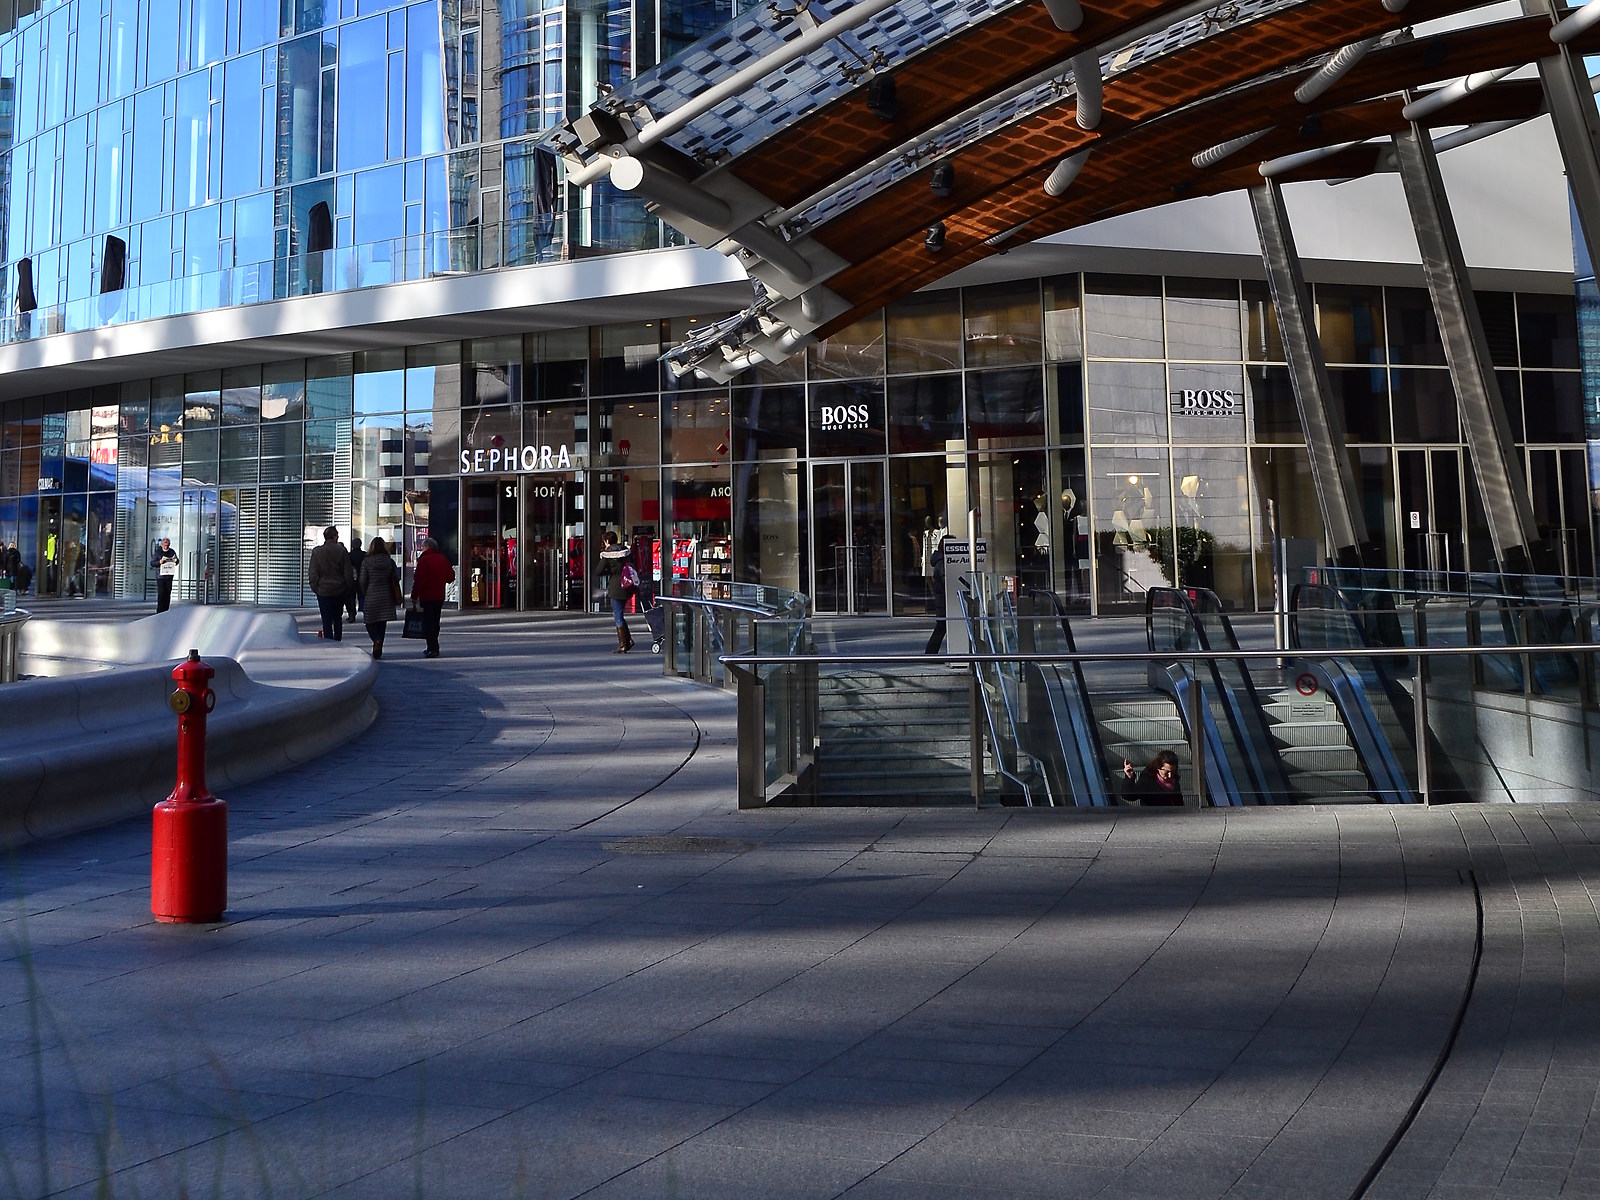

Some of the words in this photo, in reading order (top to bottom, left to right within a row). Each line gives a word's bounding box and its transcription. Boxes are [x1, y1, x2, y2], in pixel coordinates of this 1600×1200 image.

[1183, 389, 1235, 408] BOSS
[821, 404, 869, 425] BOSS
[461, 444, 572, 474] SEPHORA
